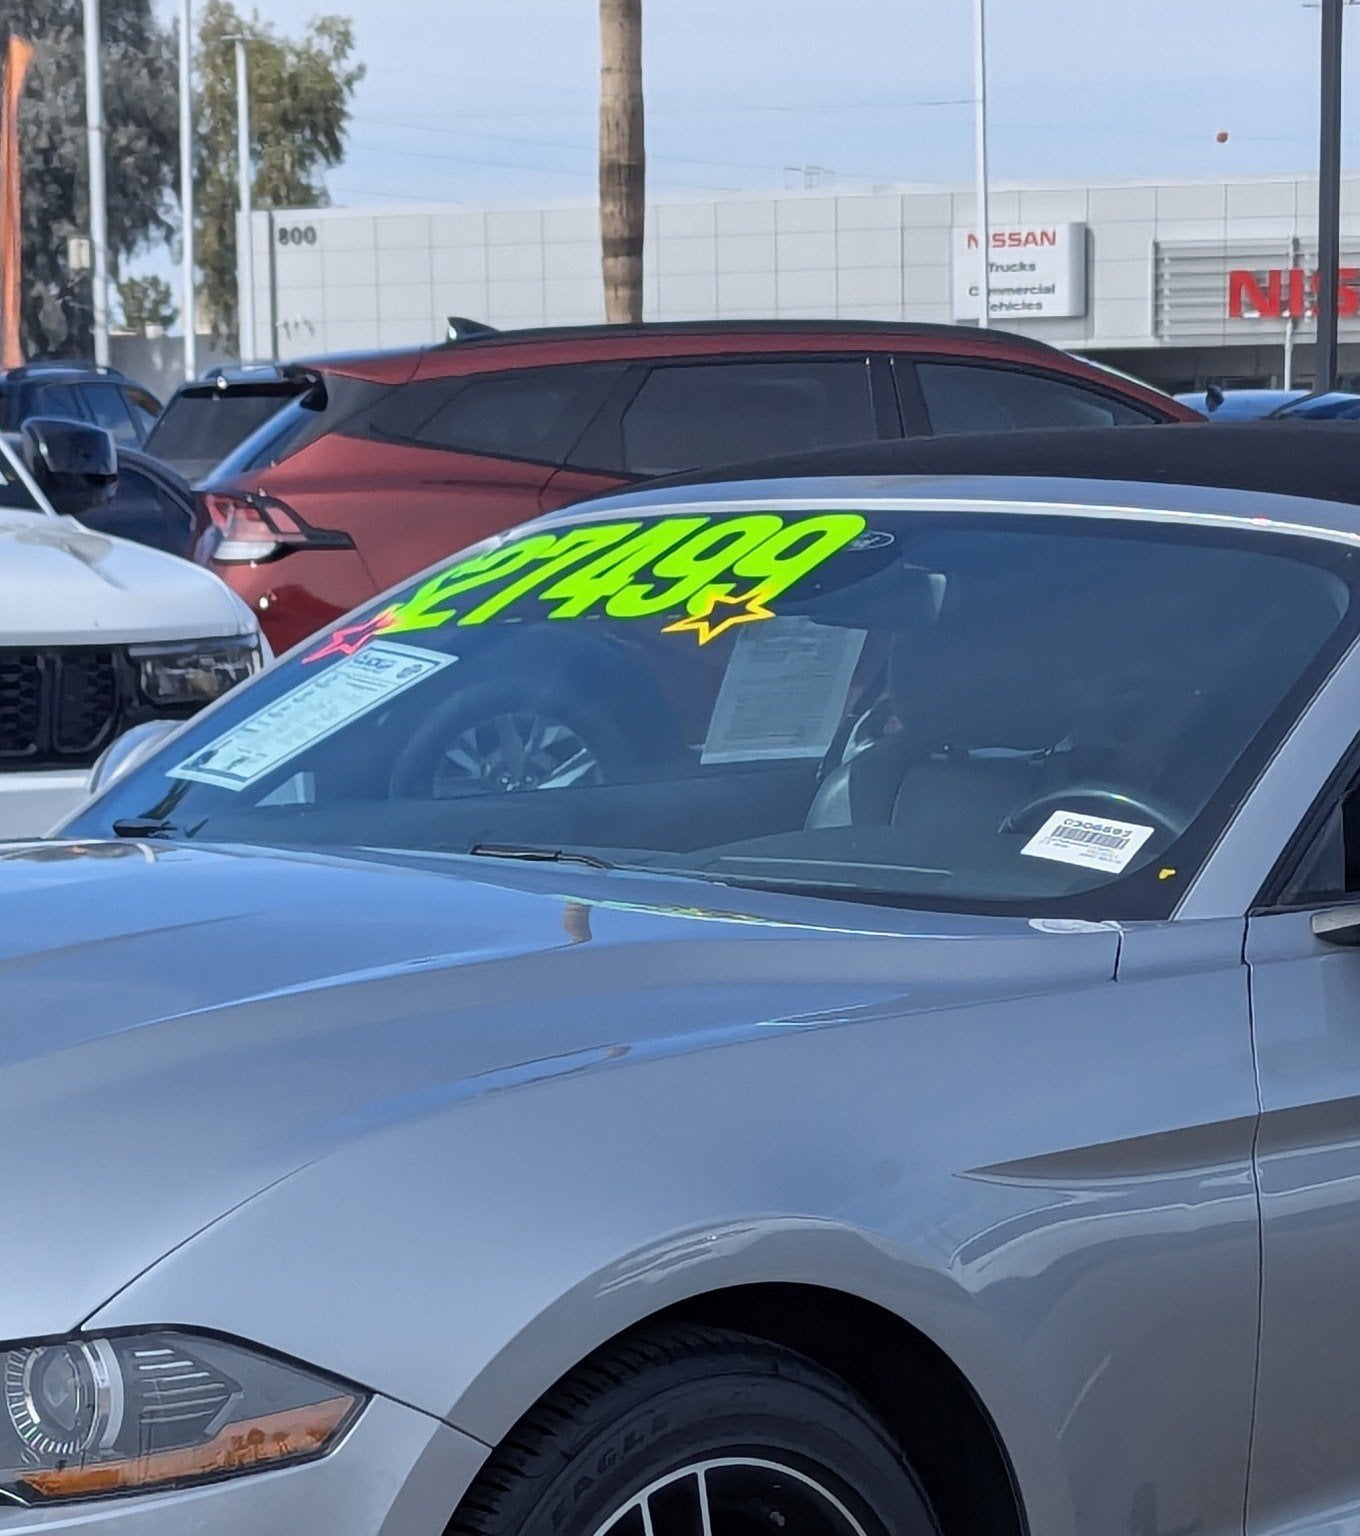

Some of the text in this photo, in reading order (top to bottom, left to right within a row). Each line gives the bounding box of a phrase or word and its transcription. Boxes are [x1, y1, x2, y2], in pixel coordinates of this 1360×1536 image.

[278, 225, 317, 246] 800
[966, 229, 1057, 249] NSSAN
[968, 283, 1056, 297] Cmmercial
[987, 301, 1043, 312] ehicles
